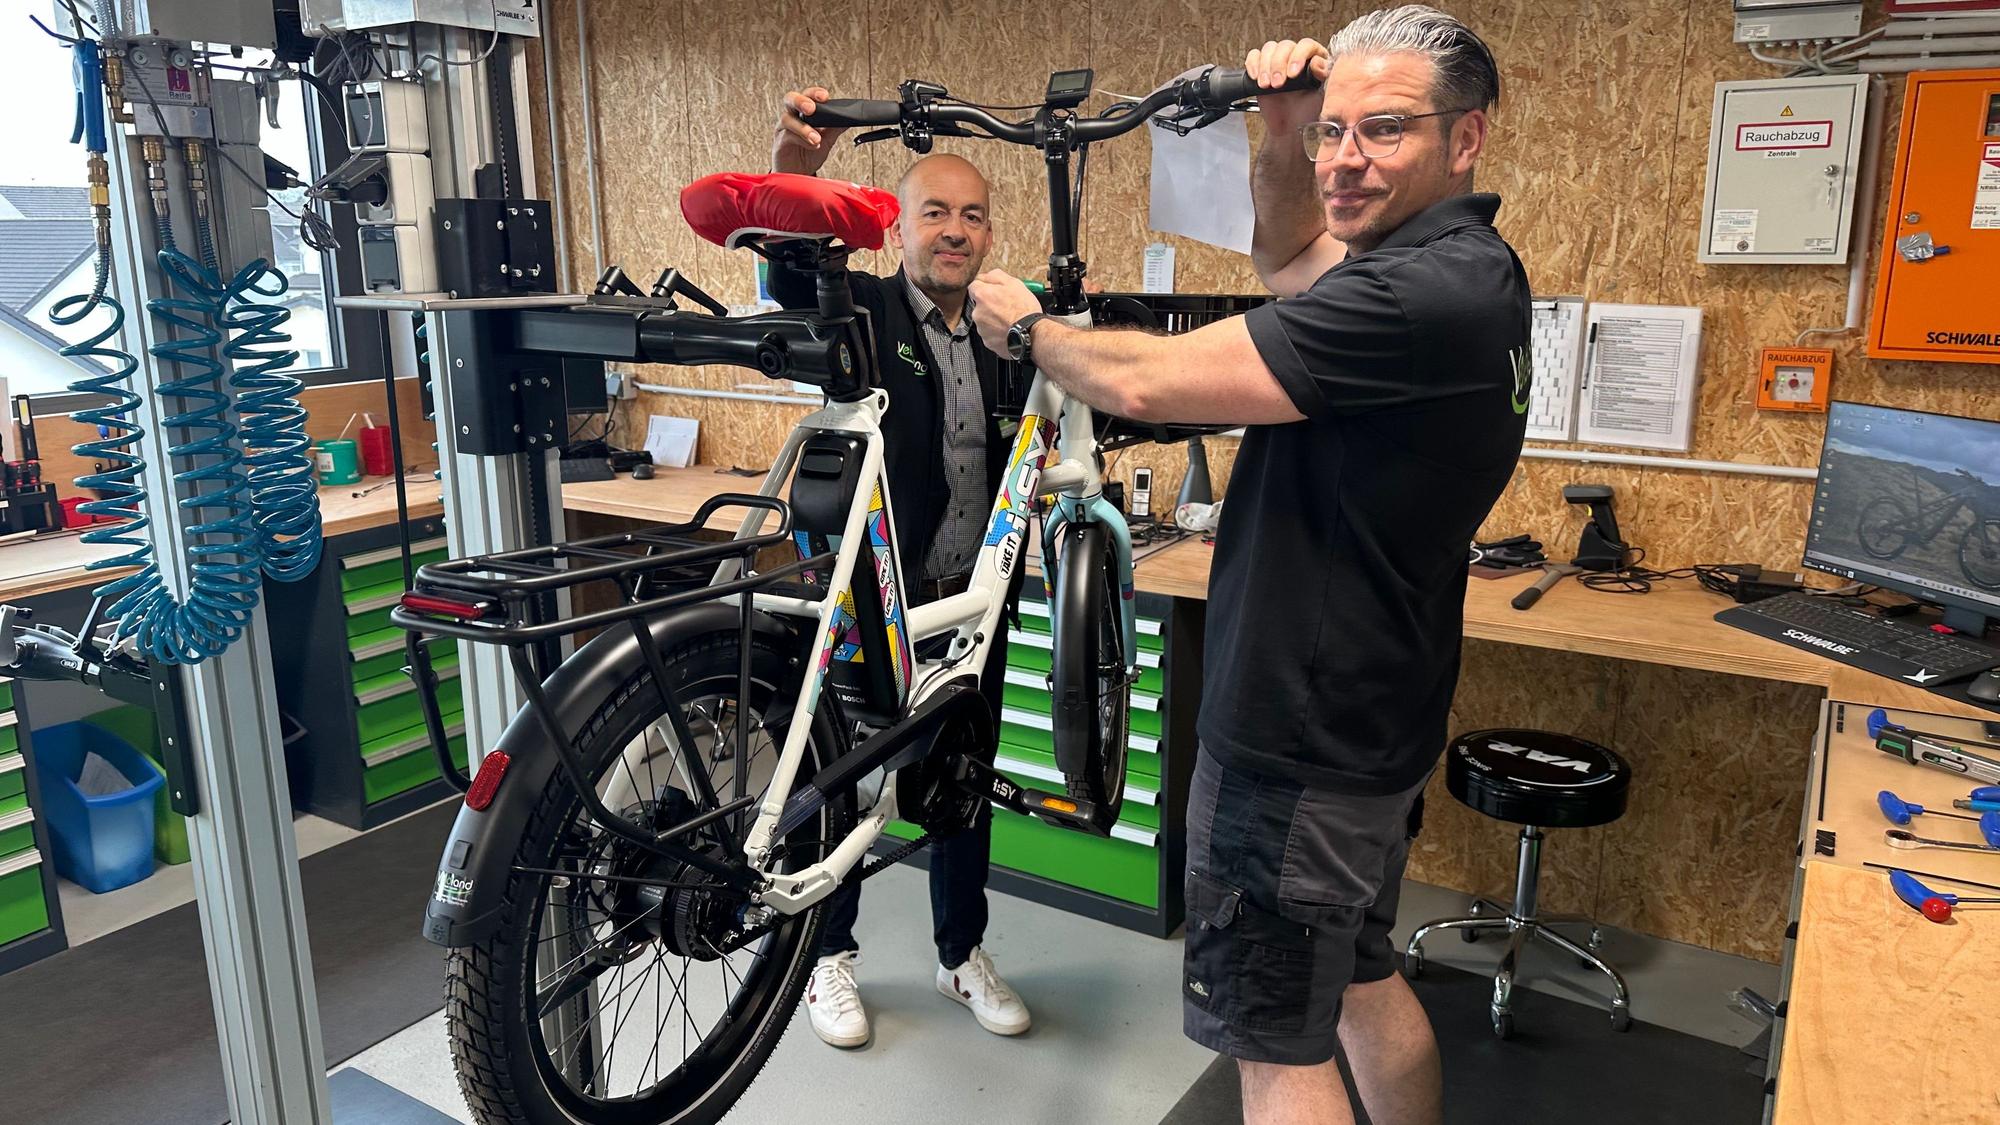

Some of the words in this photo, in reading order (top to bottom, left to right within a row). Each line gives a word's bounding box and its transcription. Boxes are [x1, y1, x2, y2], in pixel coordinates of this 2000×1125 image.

[1745, 131, 1820, 142] Rauchabzug
[1767, 354, 1825, 363] RAUCHABZUG
[1006, 535, 1017, 550] IT
[1782, 629, 1854, 655] SCHWALBE
[842, 694, 866, 704] BOSCH
[993, 779, 1016, 800] i:SY
